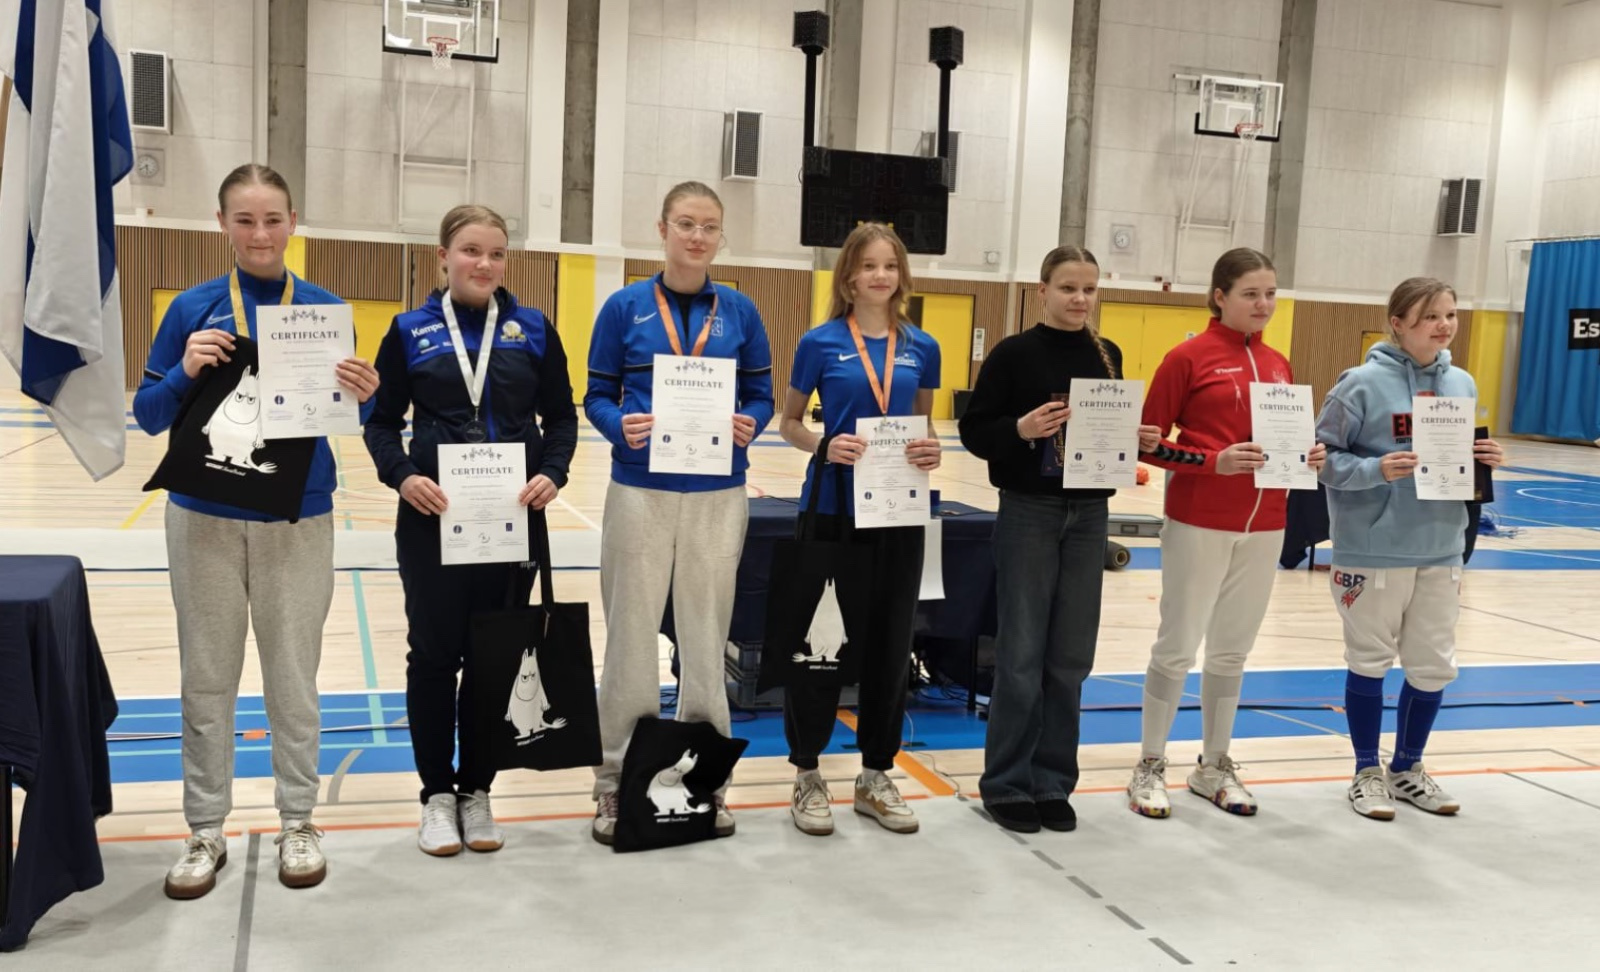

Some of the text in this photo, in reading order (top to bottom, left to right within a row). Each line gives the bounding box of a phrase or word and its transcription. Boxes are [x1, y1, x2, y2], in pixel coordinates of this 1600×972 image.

[271, 331, 340, 340] CERTIFICATE
[664, 379, 724, 389] CERTIFICATE
[1260, 404, 1305, 412] CERTIFICATE
[451, 467, 514, 476] CERTIFICATE
